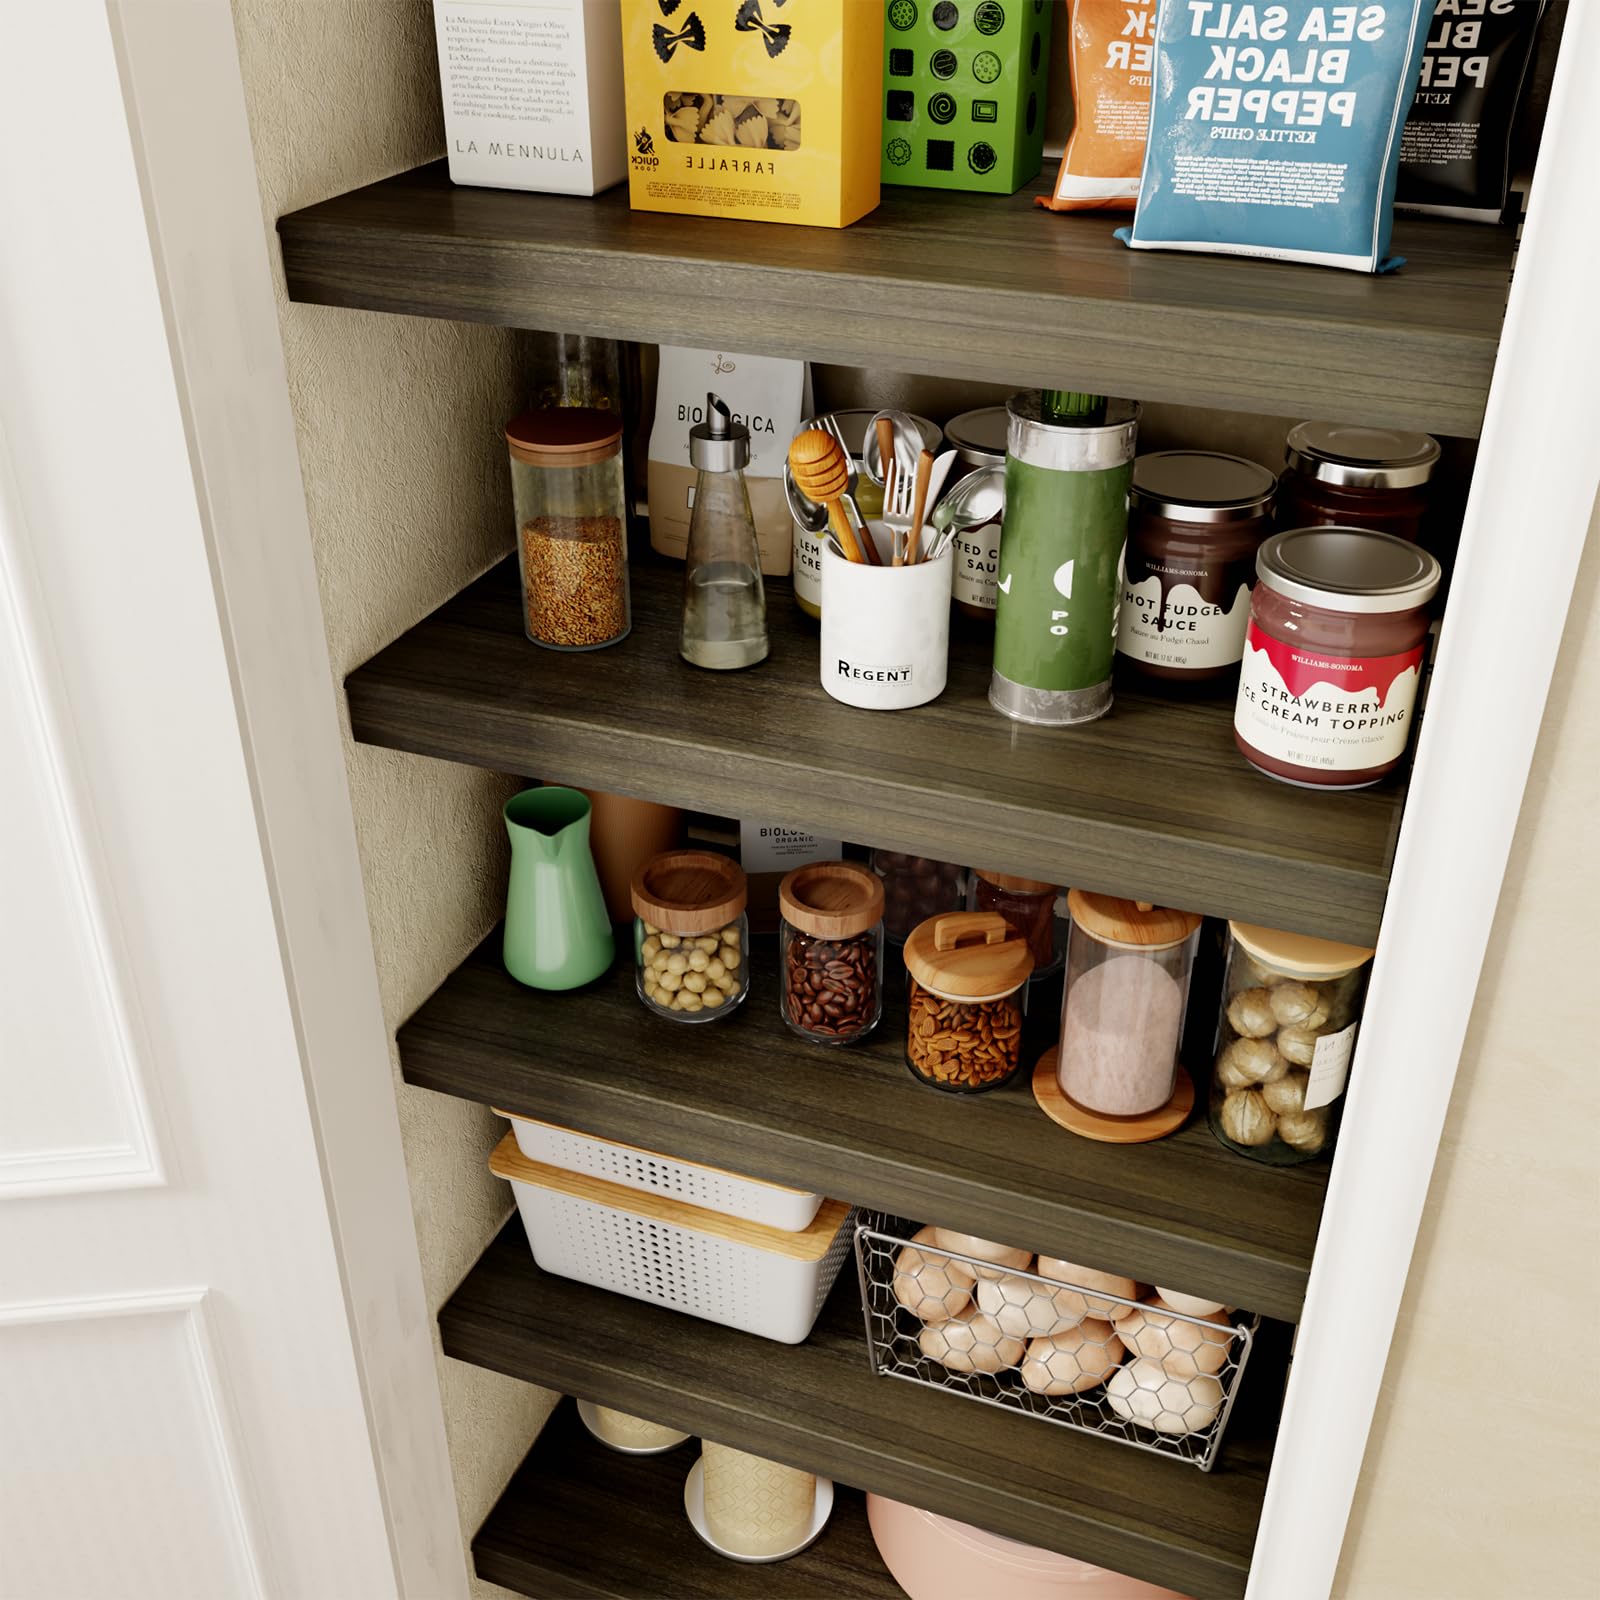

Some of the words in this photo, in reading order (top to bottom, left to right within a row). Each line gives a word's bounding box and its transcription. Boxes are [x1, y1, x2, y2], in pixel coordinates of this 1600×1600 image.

[456, 139, 478, 154] LA
[488, 142, 584, 163] MENNULA
[678, 404, 775, 434] BIOGICA
[800, 538, 819, 556] LEM
[801, 553, 822, 570] CRE
[967, 559, 996, 573] SAU
[1145, 561, 1208, 577] WILLIAMS-SONOMA
[1125, 591, 1155, 610] HOT
[1164, 603, 1221, 616] FUDGE
[1141, 613, 1197, 631] SAUCE
[838, 659, 910, 681] REGENT
[1291, 653, 1363, 672] WILLIAMS-SONOMA
[1261, 681, 1381, 714] STRAWBERRY
[1261, 699, 1319, 727] CREAM
[1330, 709, 1405, 730] TOPPING
